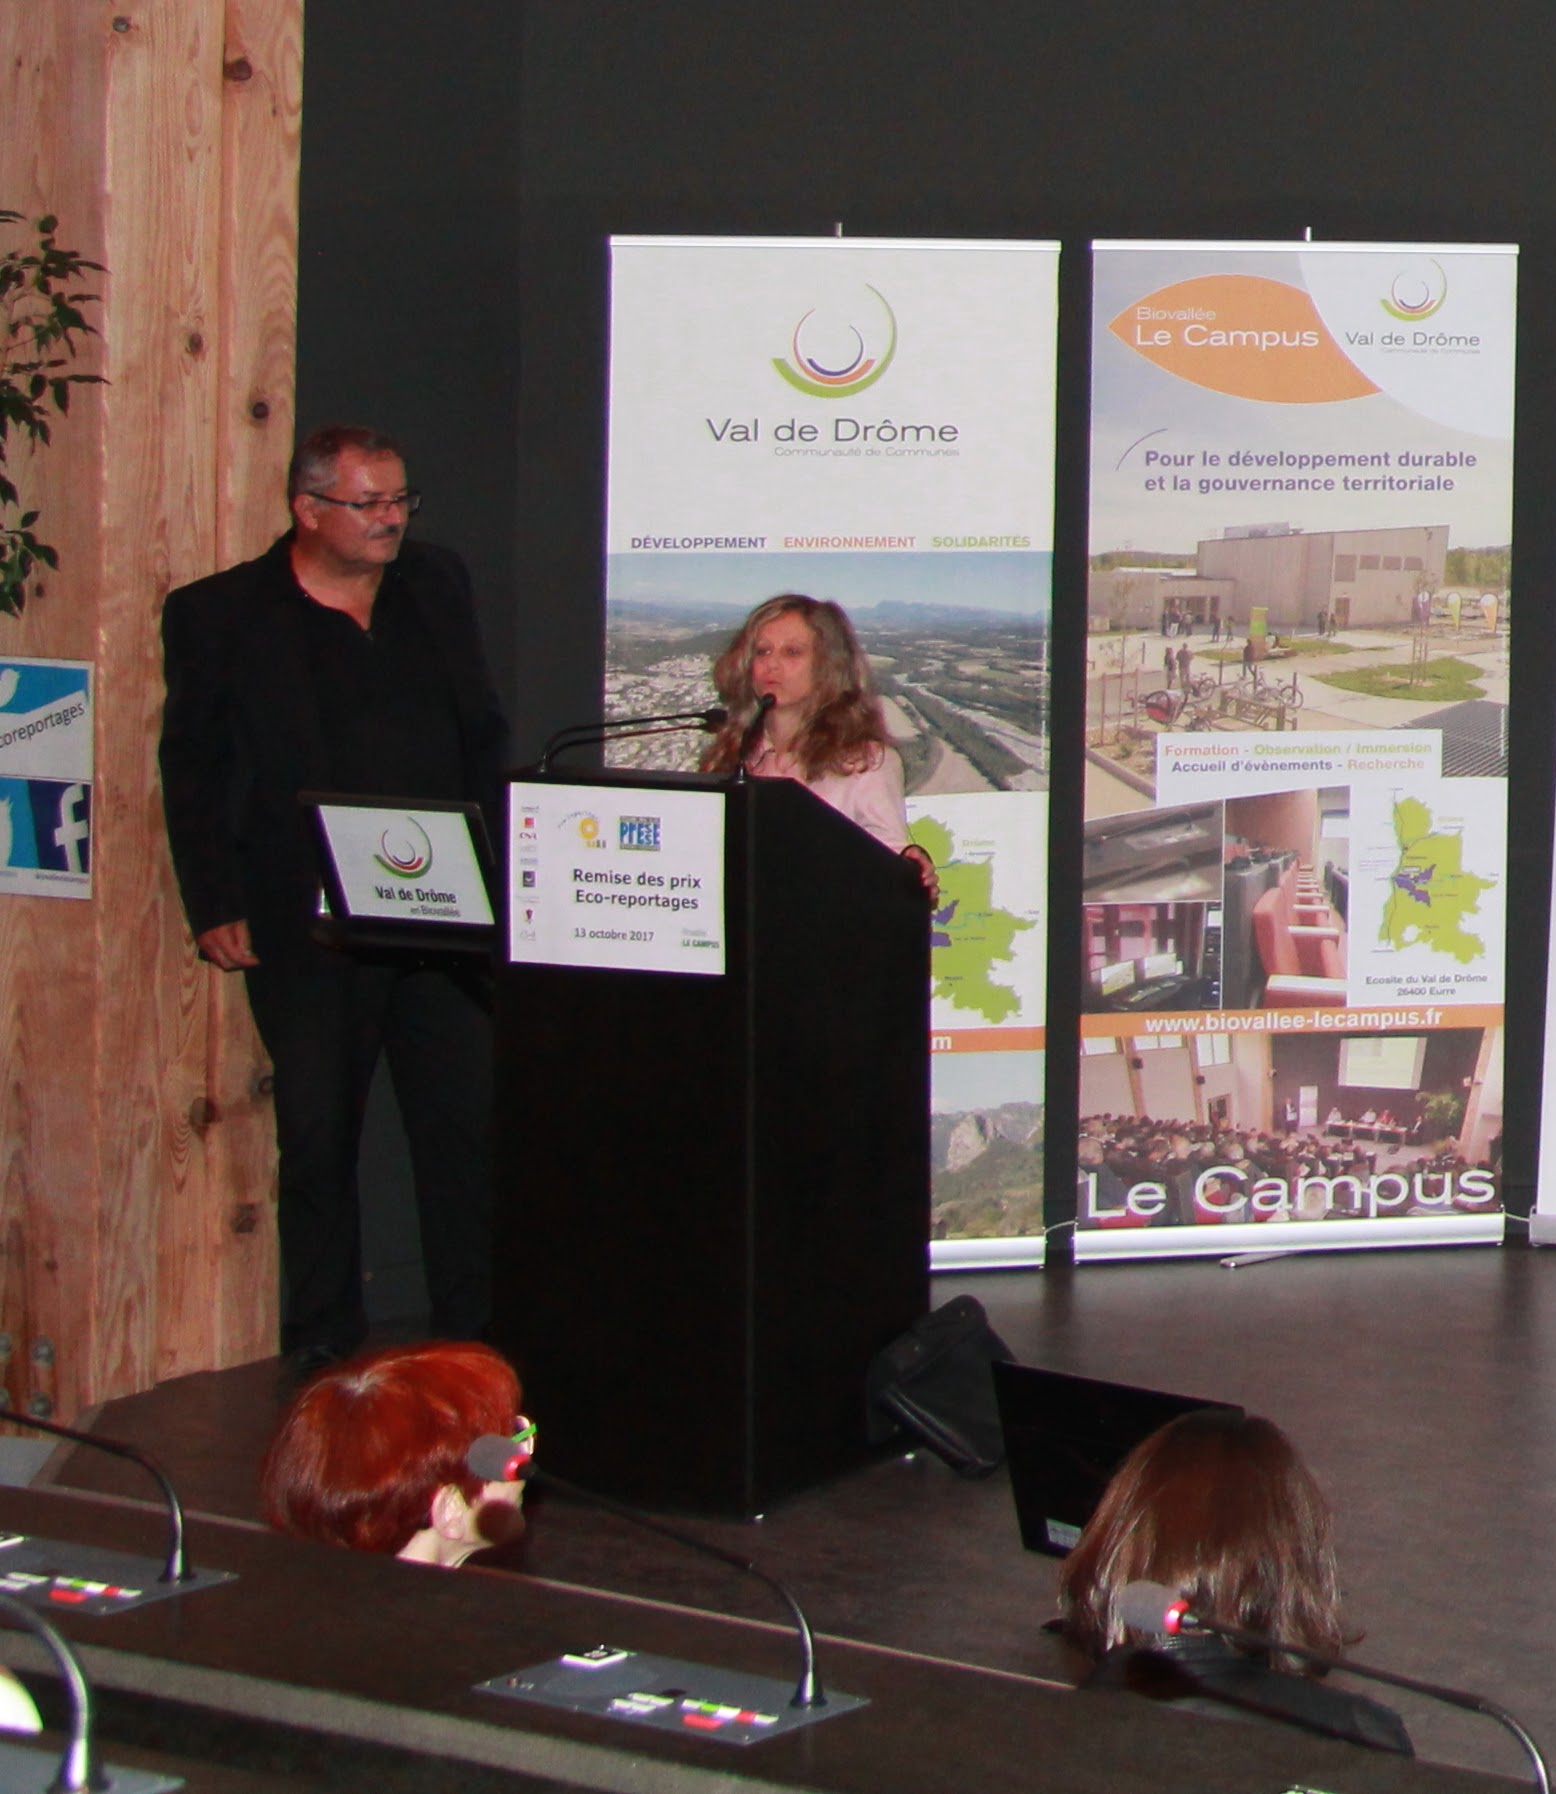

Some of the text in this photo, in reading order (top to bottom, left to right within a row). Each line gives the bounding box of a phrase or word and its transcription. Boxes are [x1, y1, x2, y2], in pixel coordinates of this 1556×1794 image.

[1136, 307, 1216, 321] Biovallée
[1136, 325, 1319, 351] Le Campus
[1345, 331, 1480, 346] Val de Drôme
[706, 418, 960, 442] Val de Drôme
[774, 446, 960, 457] Communauté de Communes
[1145, 450, 1477, 470] Pour le développement durable
[1145, 475, 1454, 494] et la gouvernance territoriale
[631, 536, 1031, 549] DÉVELOPPEMENT ENVIRONNEMENT SOLIDARITÉS
[1165, 744, 1238, 756] Formation
[1254, 743, 1340, 755] Observation
[1356, 742, 1432, 754] Immersion
[1172, 760, 1226, 773] Accueil
[1231, 758, 1333, 772] d'évènements
[1347, 758, 1425, 770] Recherche
[573, 868, 701, 890] Remise des prix
[376, 886, 456, 903] Val de Drôme
[576, 890, 699, 911] Eco-reportages
[575, 928, 654, 941] 13 octobre 2017
[1406, 975, 1418, 985] du
[1421, 974, 1436, 985] Val
[1438, 974, 1451, 985] de
[1454, 973, 1487, 983] Drôme
[1397, 987, 1425, 996] 26400
[1146, 1009, 1443, 1033] www.biovallee-lecampus.fr
[1087, 1165, 1496, 1219] Le Campus
